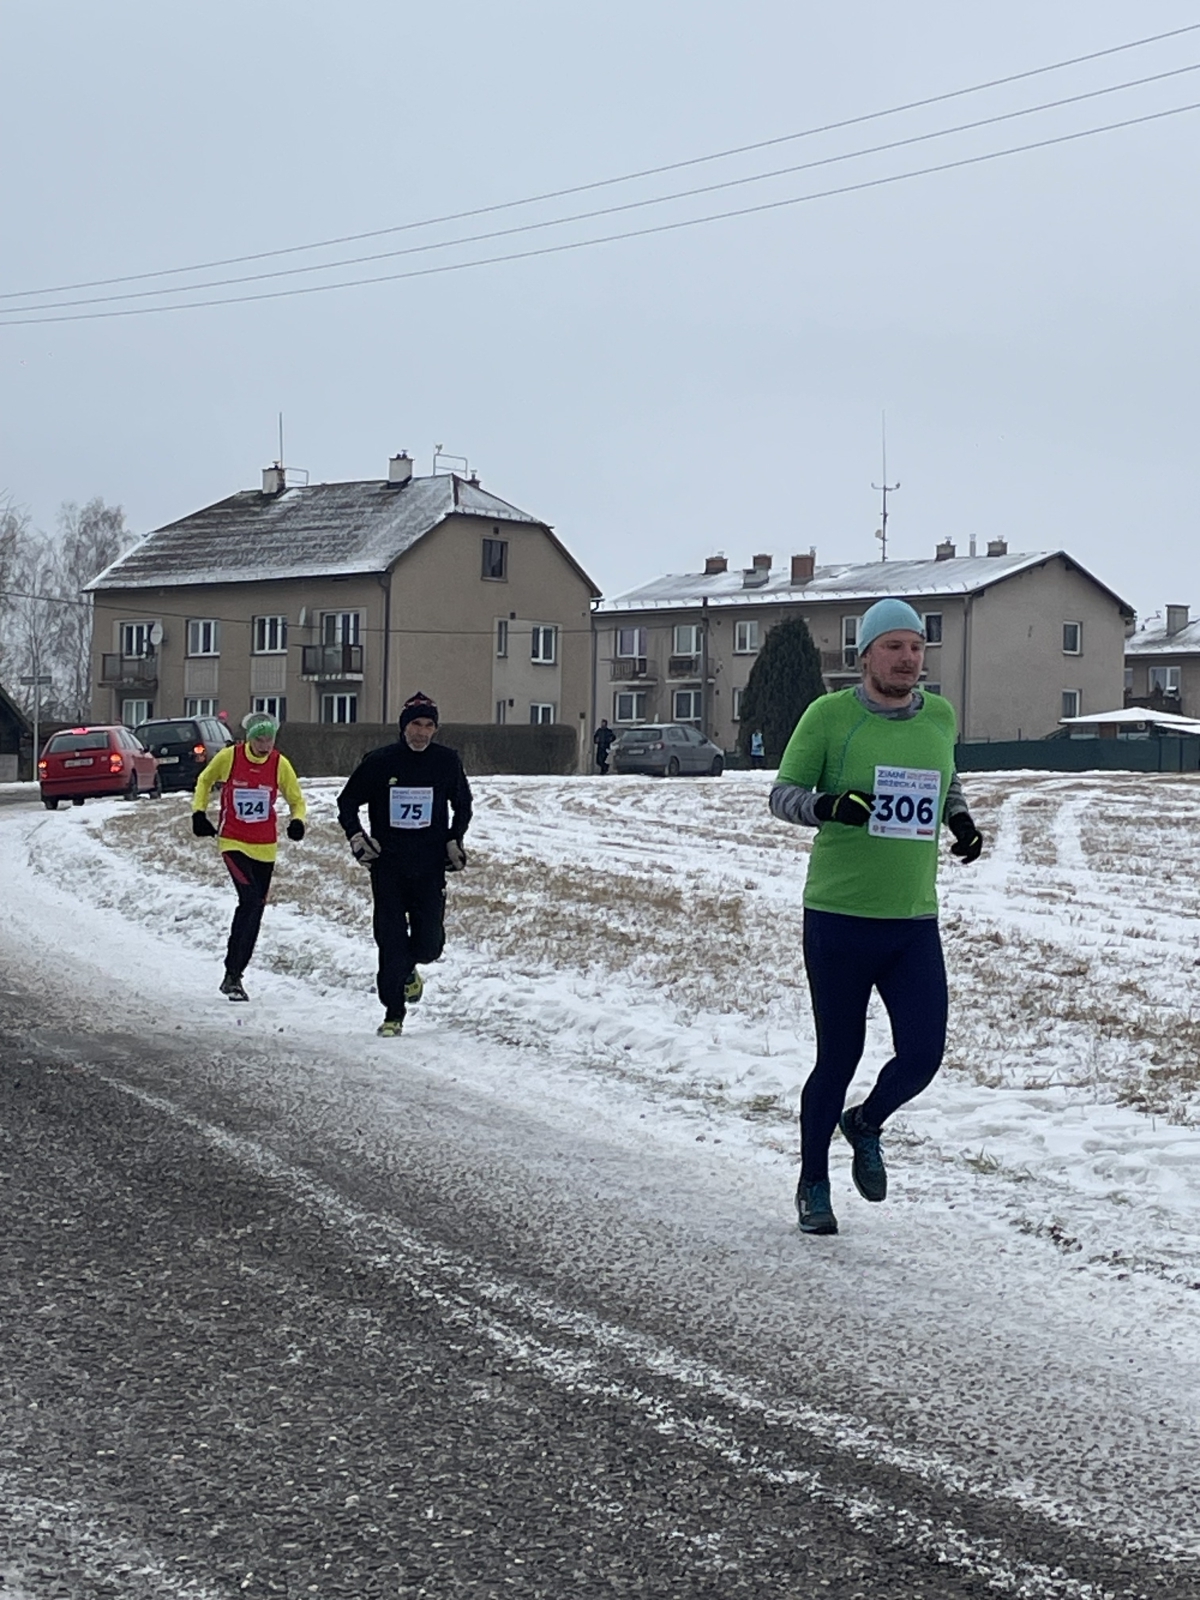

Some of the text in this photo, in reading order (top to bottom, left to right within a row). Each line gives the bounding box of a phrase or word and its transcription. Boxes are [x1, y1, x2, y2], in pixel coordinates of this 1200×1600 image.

[237, 801, 265, 816] 124
[400, 803, 423, 820] 75
[875, 794, 934, 825] 306
